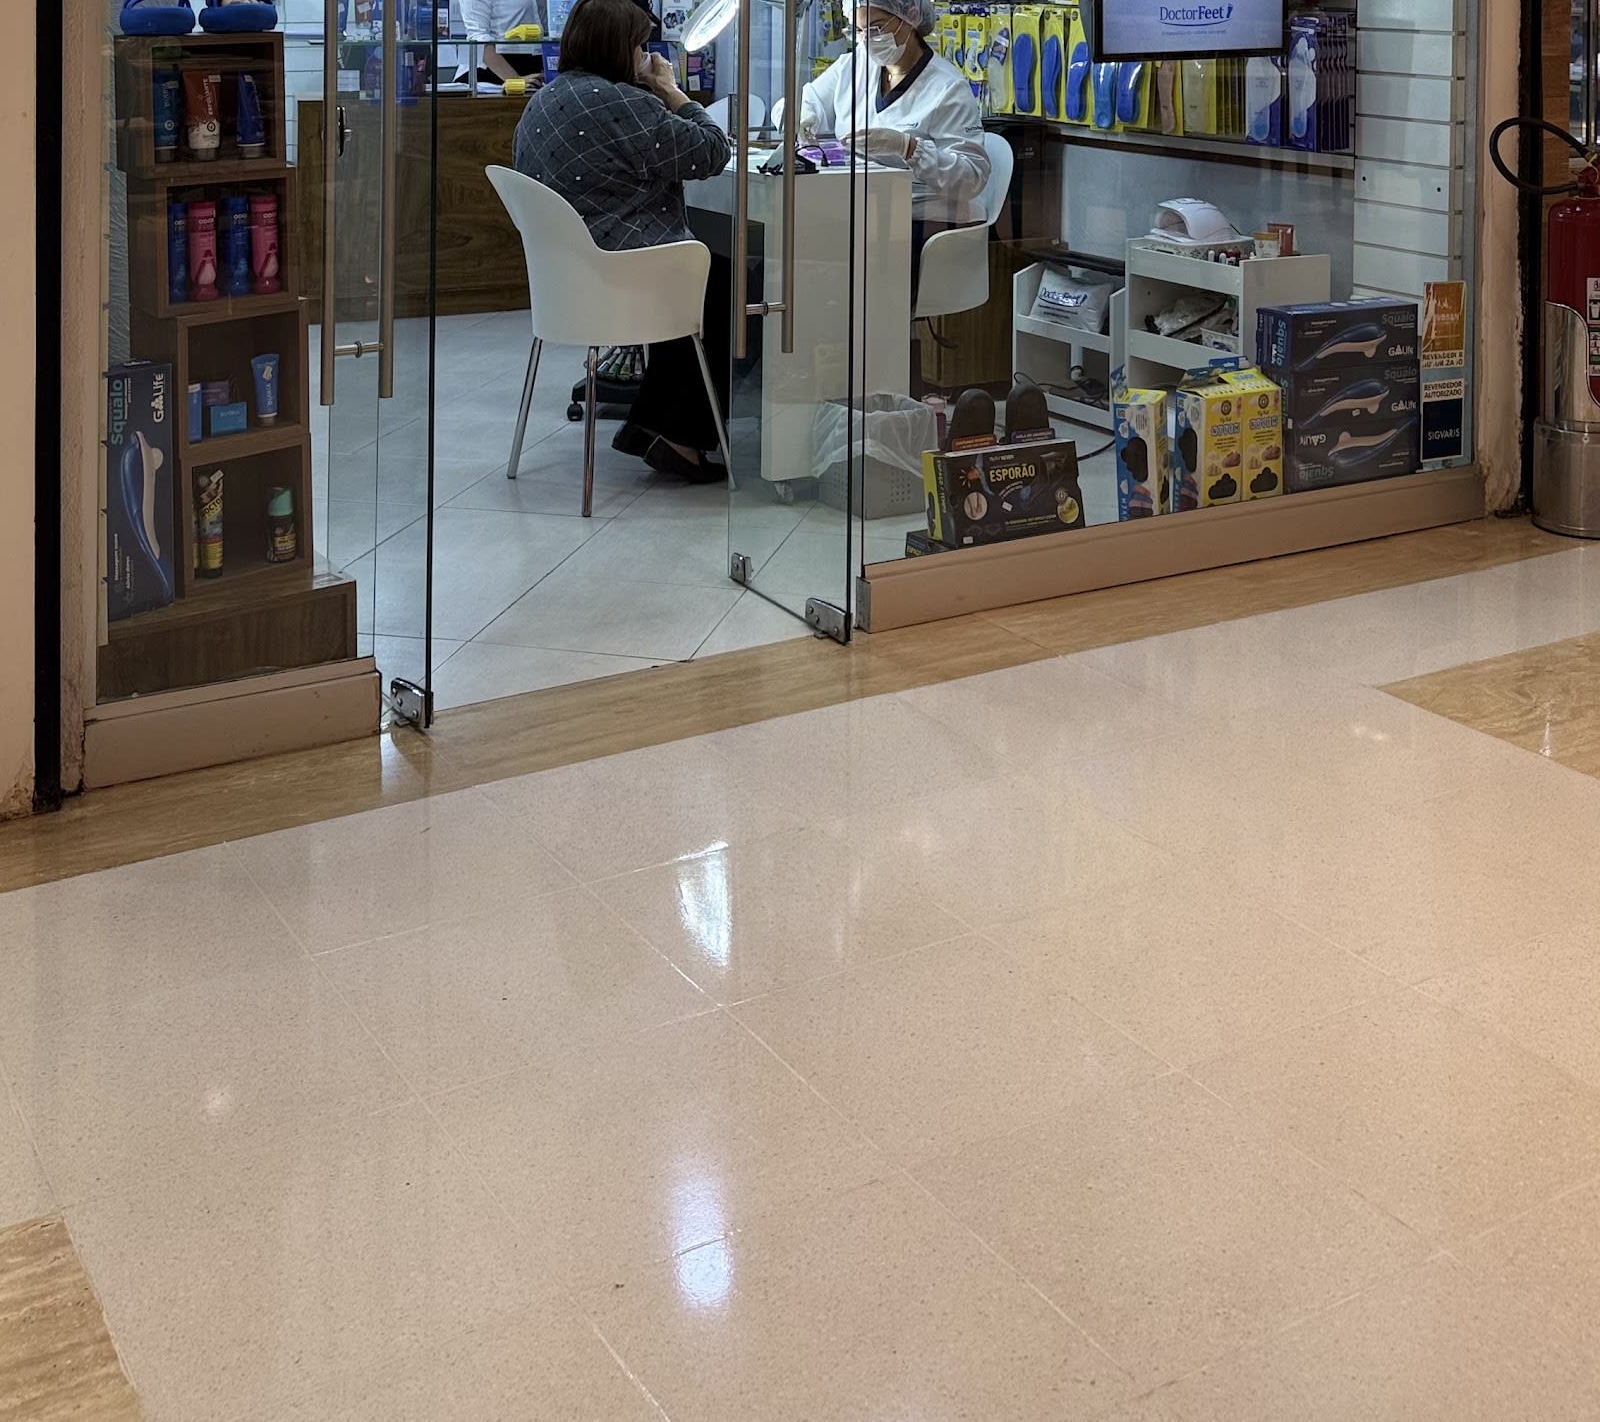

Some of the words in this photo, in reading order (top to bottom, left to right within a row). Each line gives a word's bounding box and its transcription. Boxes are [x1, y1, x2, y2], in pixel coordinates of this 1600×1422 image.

[1381, 311, 1416, 326] Squalo
[1276, 319, 1287, 368] Squalo
[1423, 380, 1463, 391] REVENDEDOR
[1424, 388, 1463, 399] AUTORIZADO
[109, 378, 128, 446] Squalo
[1427, 427, 1461, 441] SIGVARIS
[989, 462, 1036, 483] ESPORÃO
